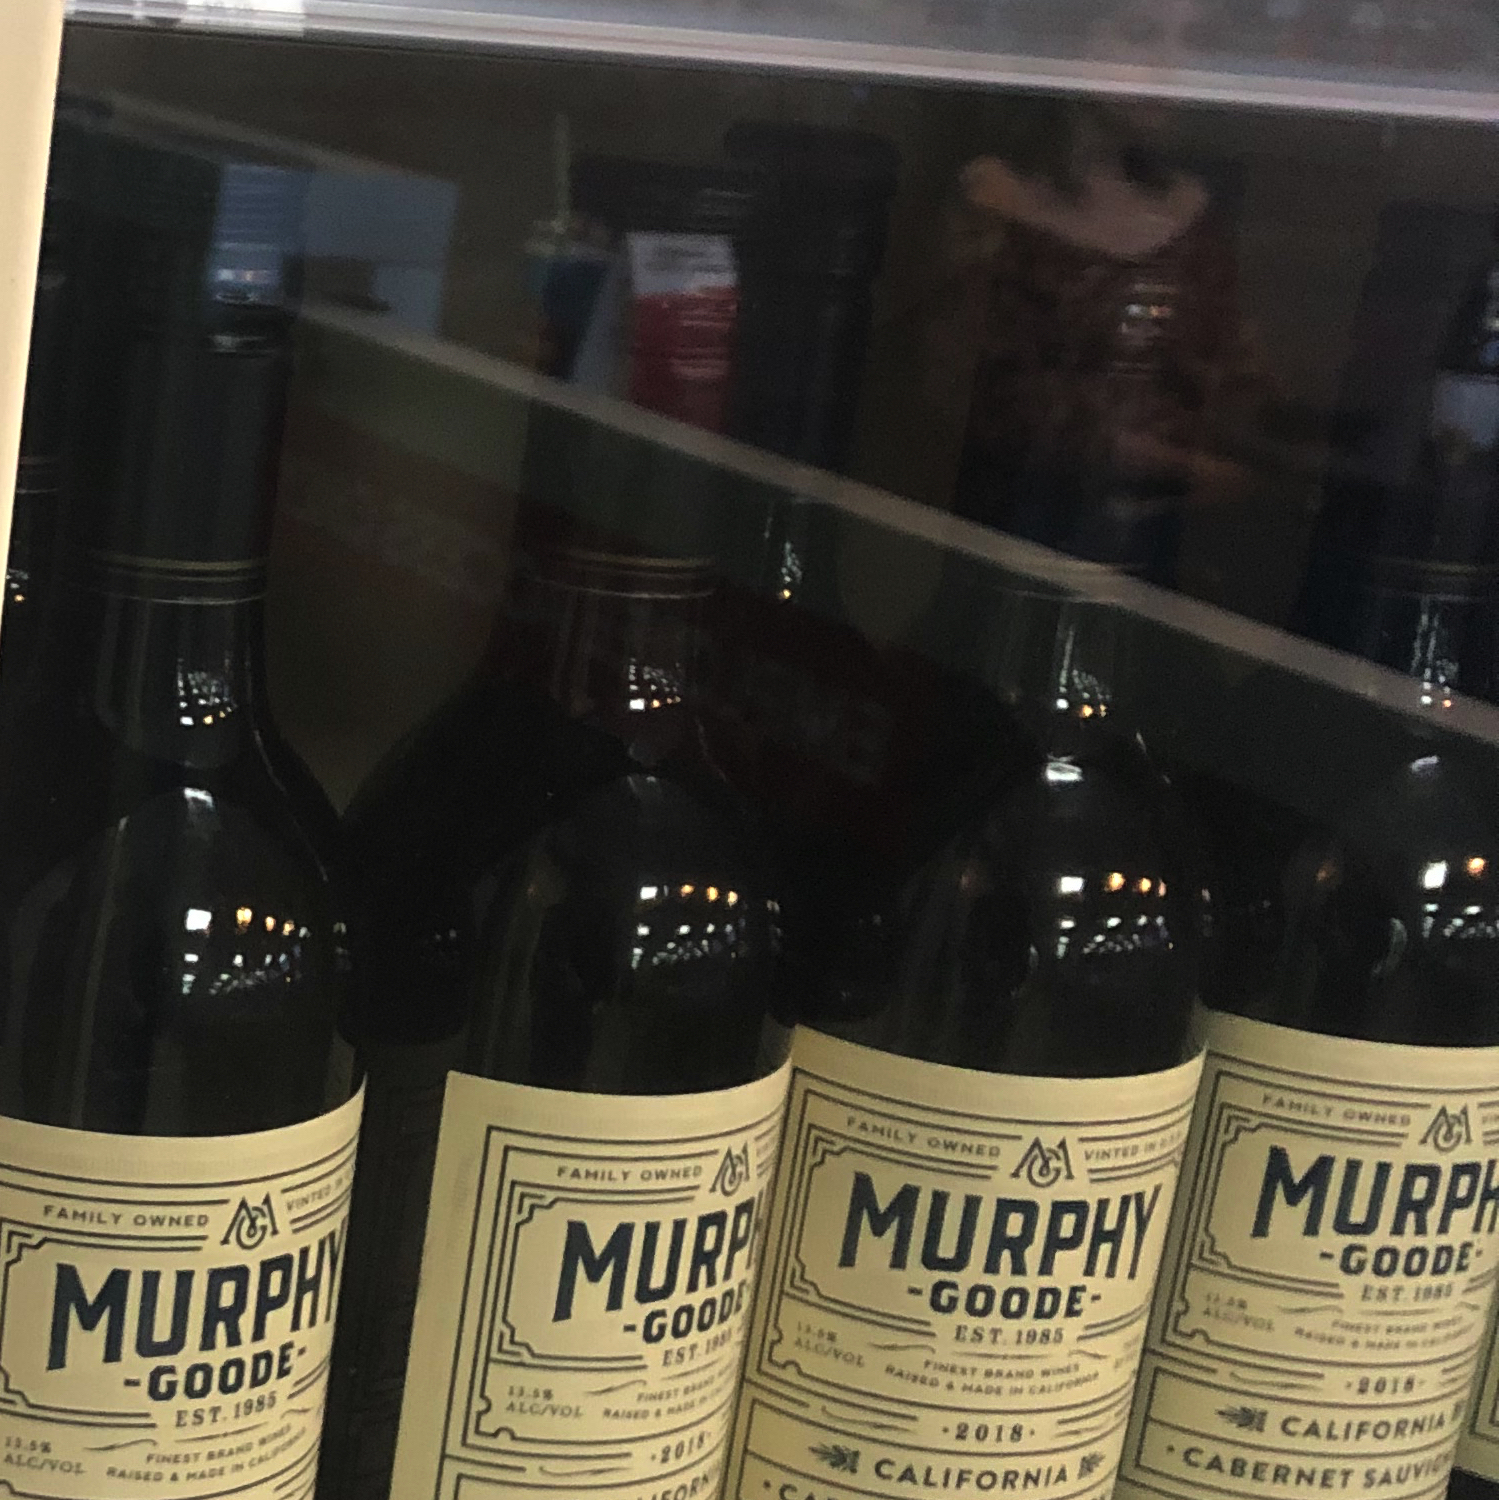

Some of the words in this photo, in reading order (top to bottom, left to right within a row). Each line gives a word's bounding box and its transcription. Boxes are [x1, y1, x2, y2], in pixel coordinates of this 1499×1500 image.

[846, 1116, 917, 1143] FAMILY
[927, 1137, 1003, 1158] OWNED
[1084, 1143, 1140, 1161] VINTED
[557, 1165, 631, 1182] FAMILY
[640, 1165, 703, 1181] OWNED
[42, 1204, 122, 1226] FAMILY
[133, 1213, 209, 1228] OWNED
[838, 1171, 1162, 1281] MURPHY
[46, 1217, 348, 1371] MURPHY
[1015, 1327, 1064, 1346] 1985
[234, 1391, 277, 1418] 1985
[1280, 1412, 1445, 1441] CALIFORNIA
[873, 1458, 1068, 1491] CALIFORNIA
[1182, 1447, 1353, 1489] CABERNET
